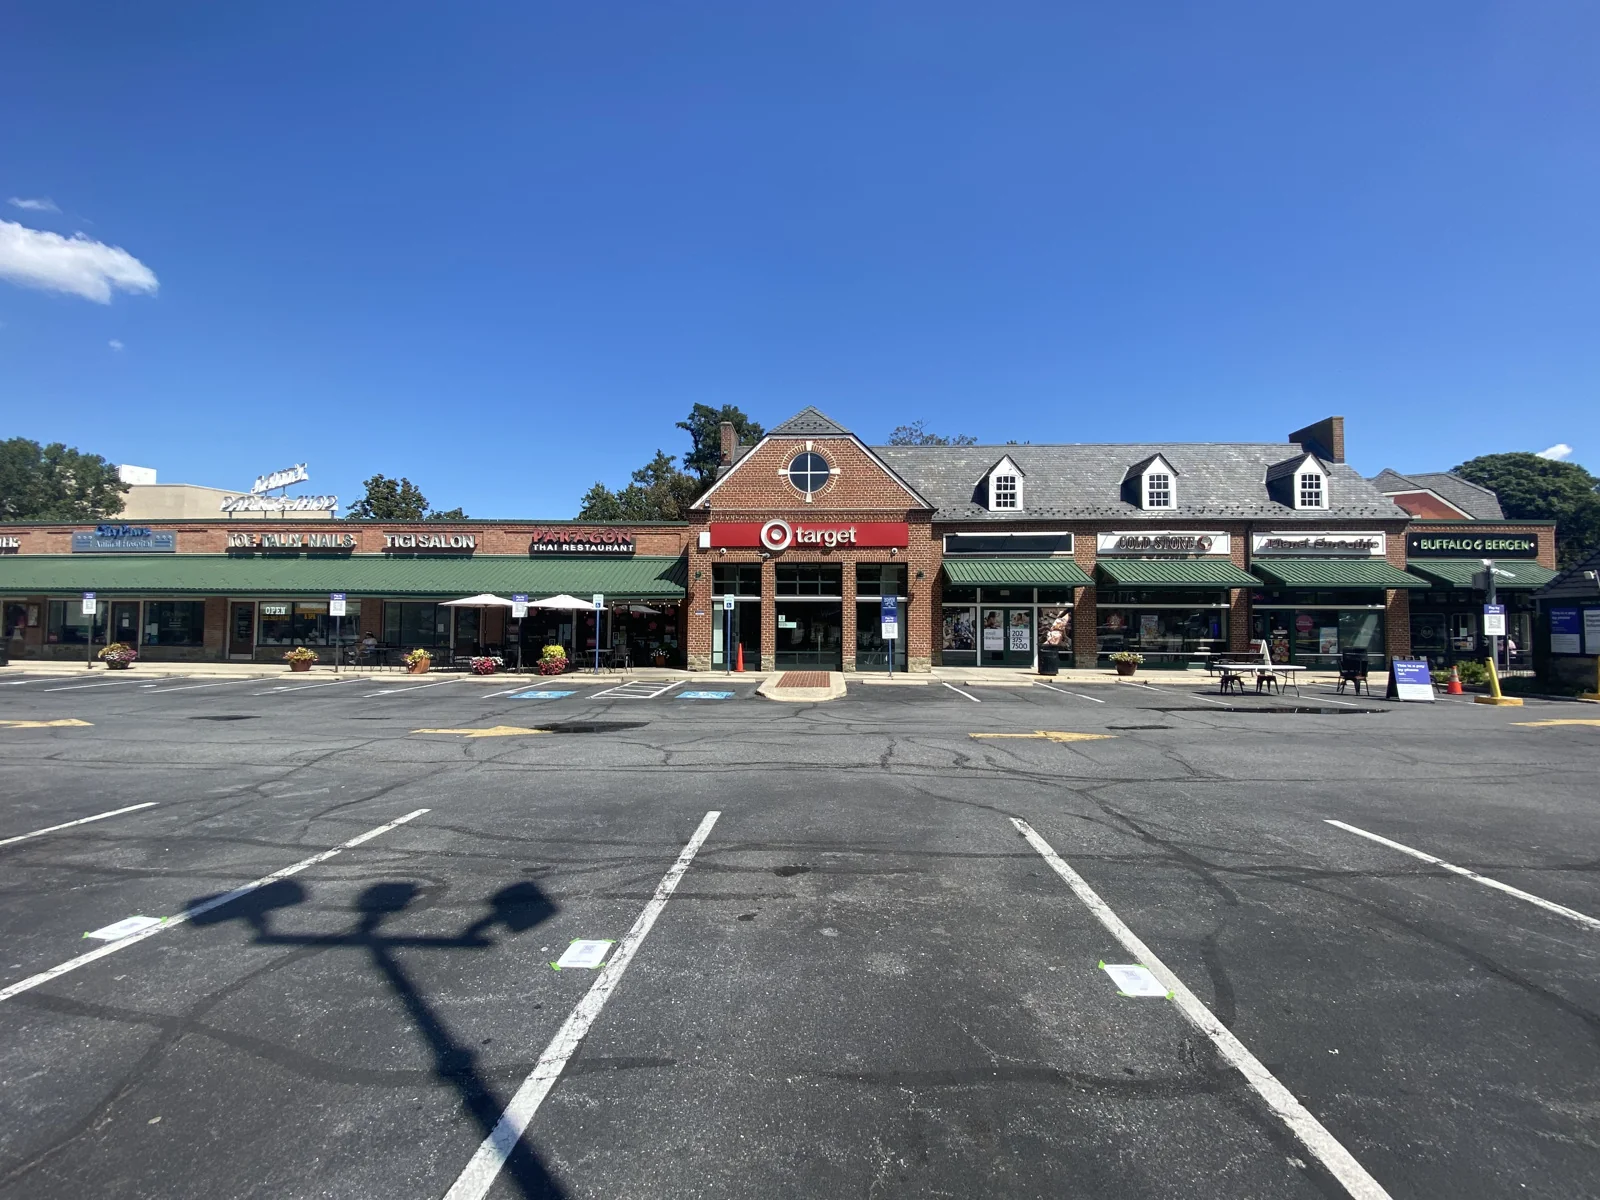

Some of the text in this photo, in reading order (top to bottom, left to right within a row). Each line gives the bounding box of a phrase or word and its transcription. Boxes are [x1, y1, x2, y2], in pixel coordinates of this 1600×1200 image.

[288, 495, 338, 511] SHOP
[226, 533, 356, 547] TOE TALLY NAILS
[383, 534, 475, 548] TIGI SALON
[533, 529, 633, 543] PARAGON
[796, 526, 857, 547] target
[1119, 535, 1195, 550] COLD STONE
[562, 544, 633, 552] RESTAURANT
[1420, 539, 1472, 550] BUFFALO
[1485, 539, 1530, 550] BERGEN
[265, 606, 286, 615] OPEN
